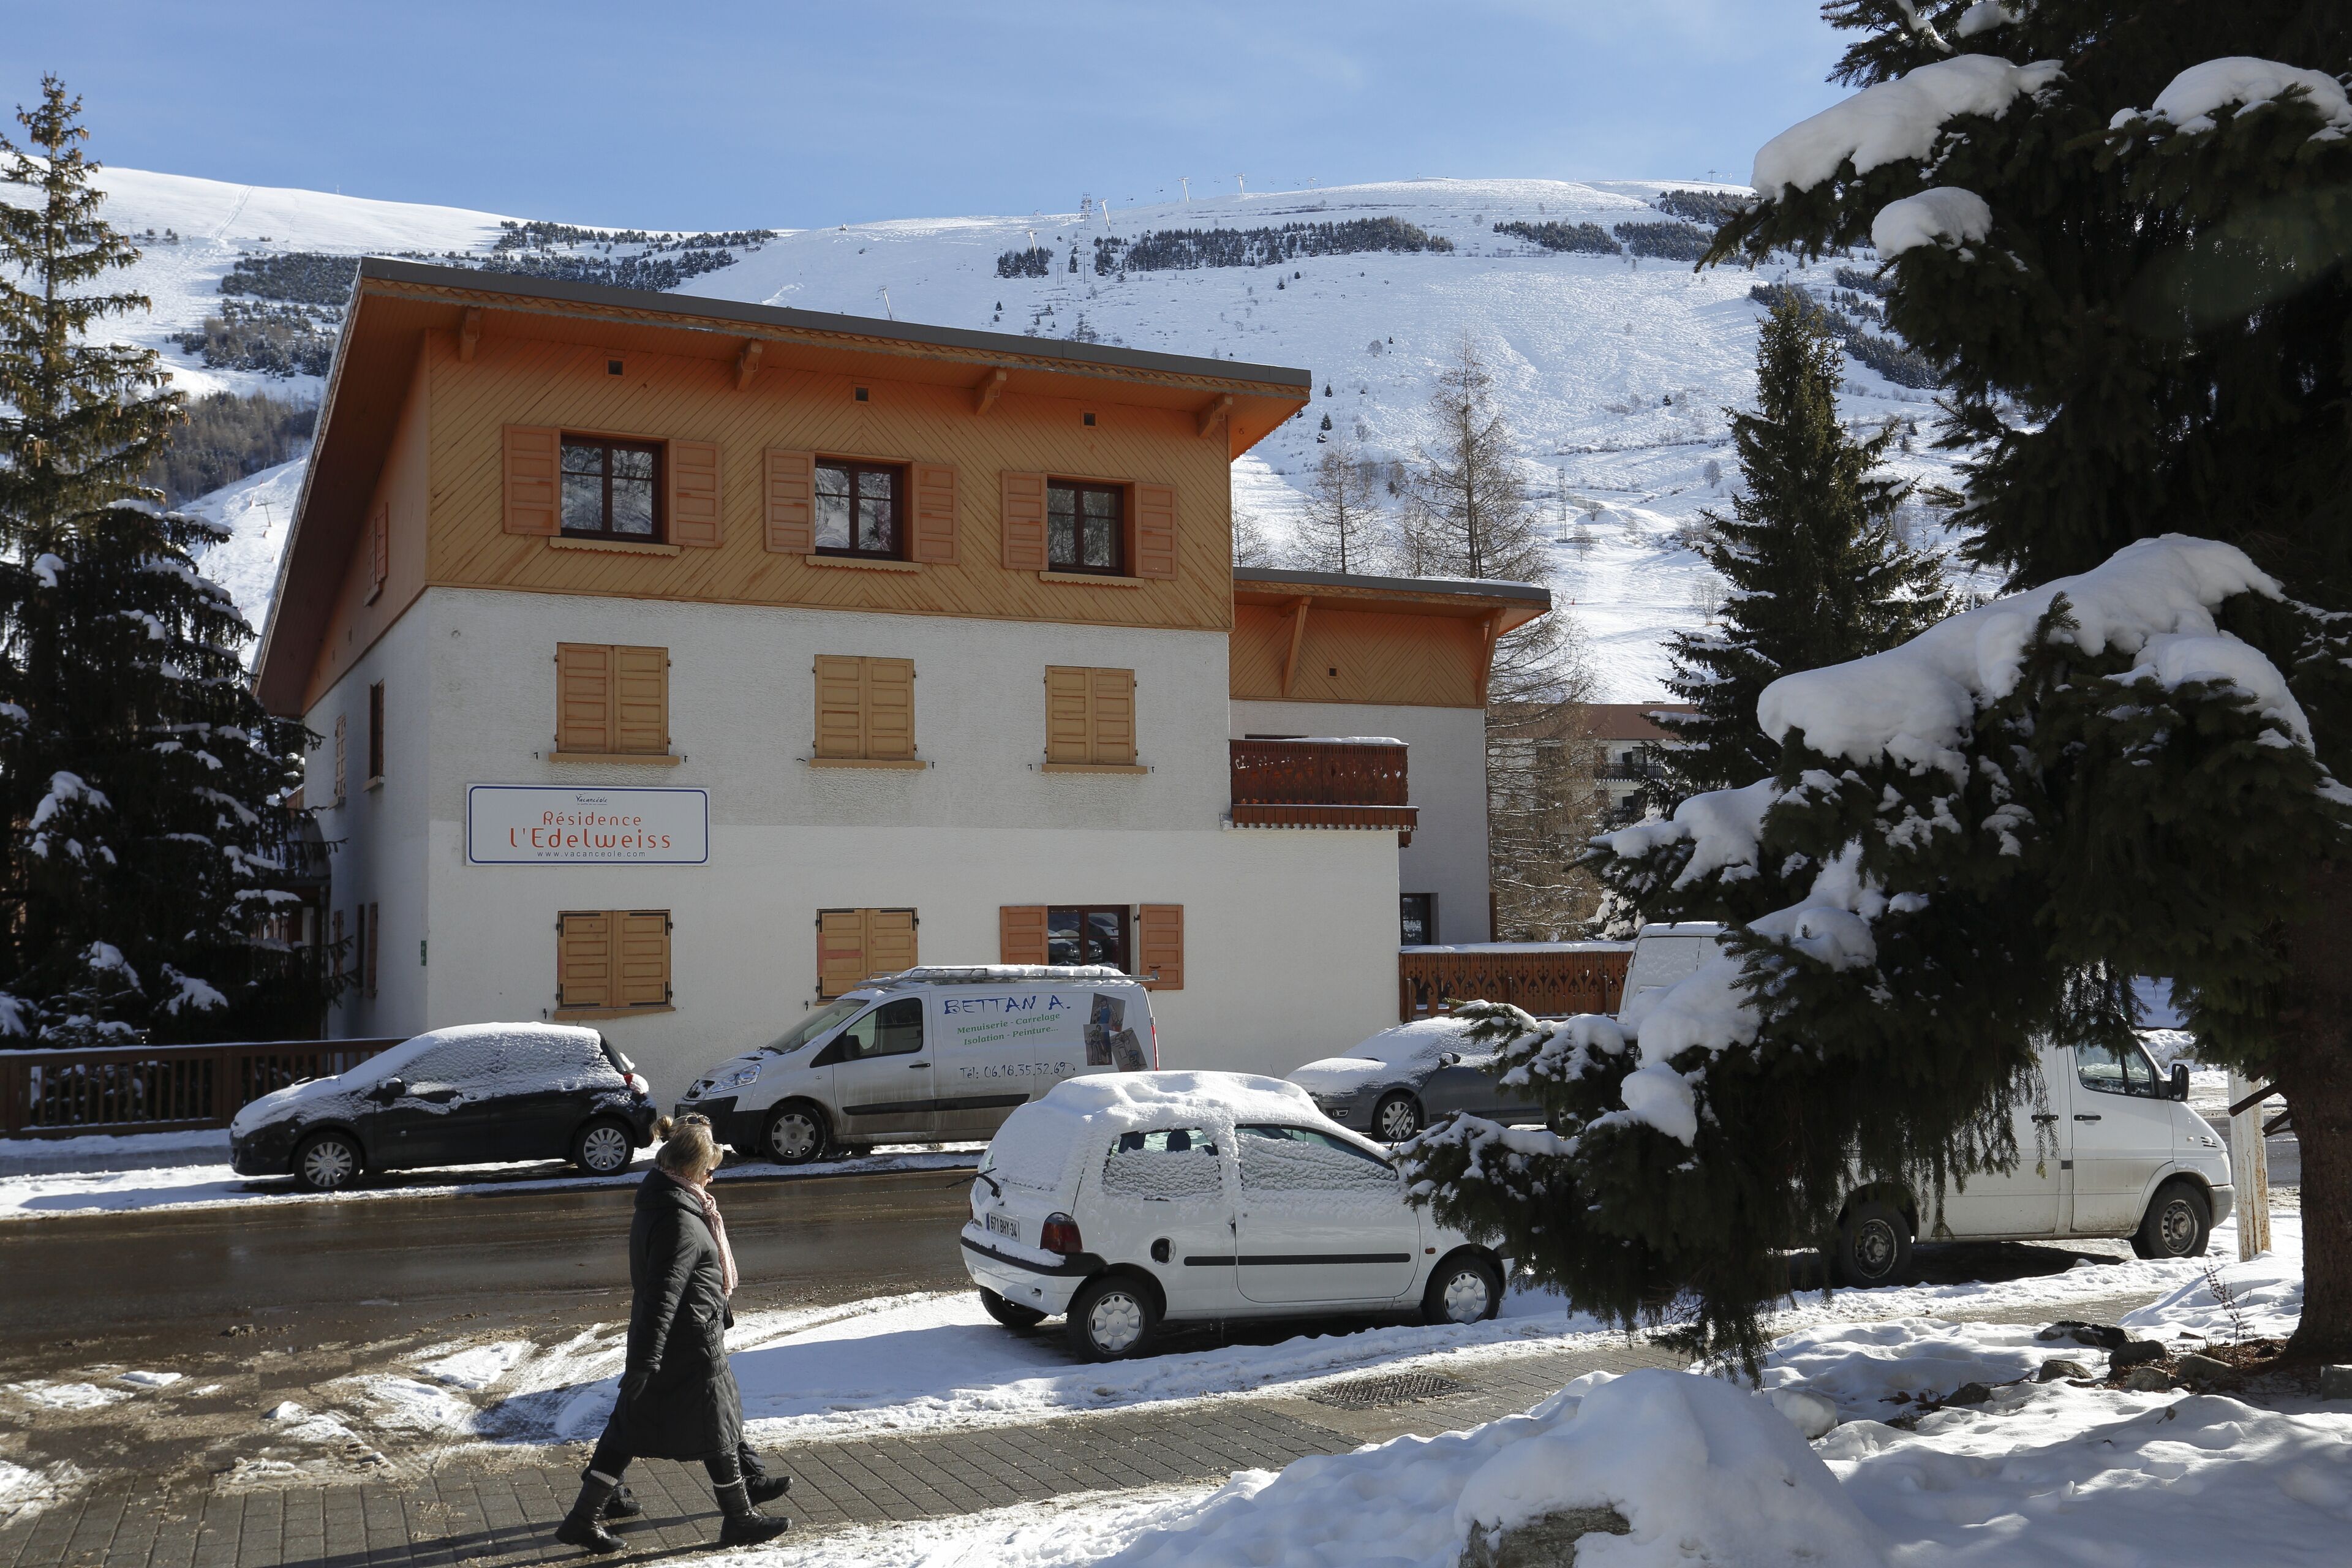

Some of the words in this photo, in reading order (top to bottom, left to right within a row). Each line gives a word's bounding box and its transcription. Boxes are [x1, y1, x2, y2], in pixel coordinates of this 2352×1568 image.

[543, 811, 641, 826] Résidence
[510, 827, 671, 849] l'Edelweiss
[944, 995, 1037, 1014] BETTAN
[1048, 995, 1071, 1011] A.
[957, 1020, 1008, 1035] Menuiserie
[1016, 1013, 1060, 1025] Carrelage
[963, 1034, 1005, 1046] Isolation
[1012, 1026, 1059, 1038] Peinture...
[959, 1067, 979, 1079] Tél:
[990, 1215, 999, 1232] 671
[1000, 1219, 1009, 1235] BHY
